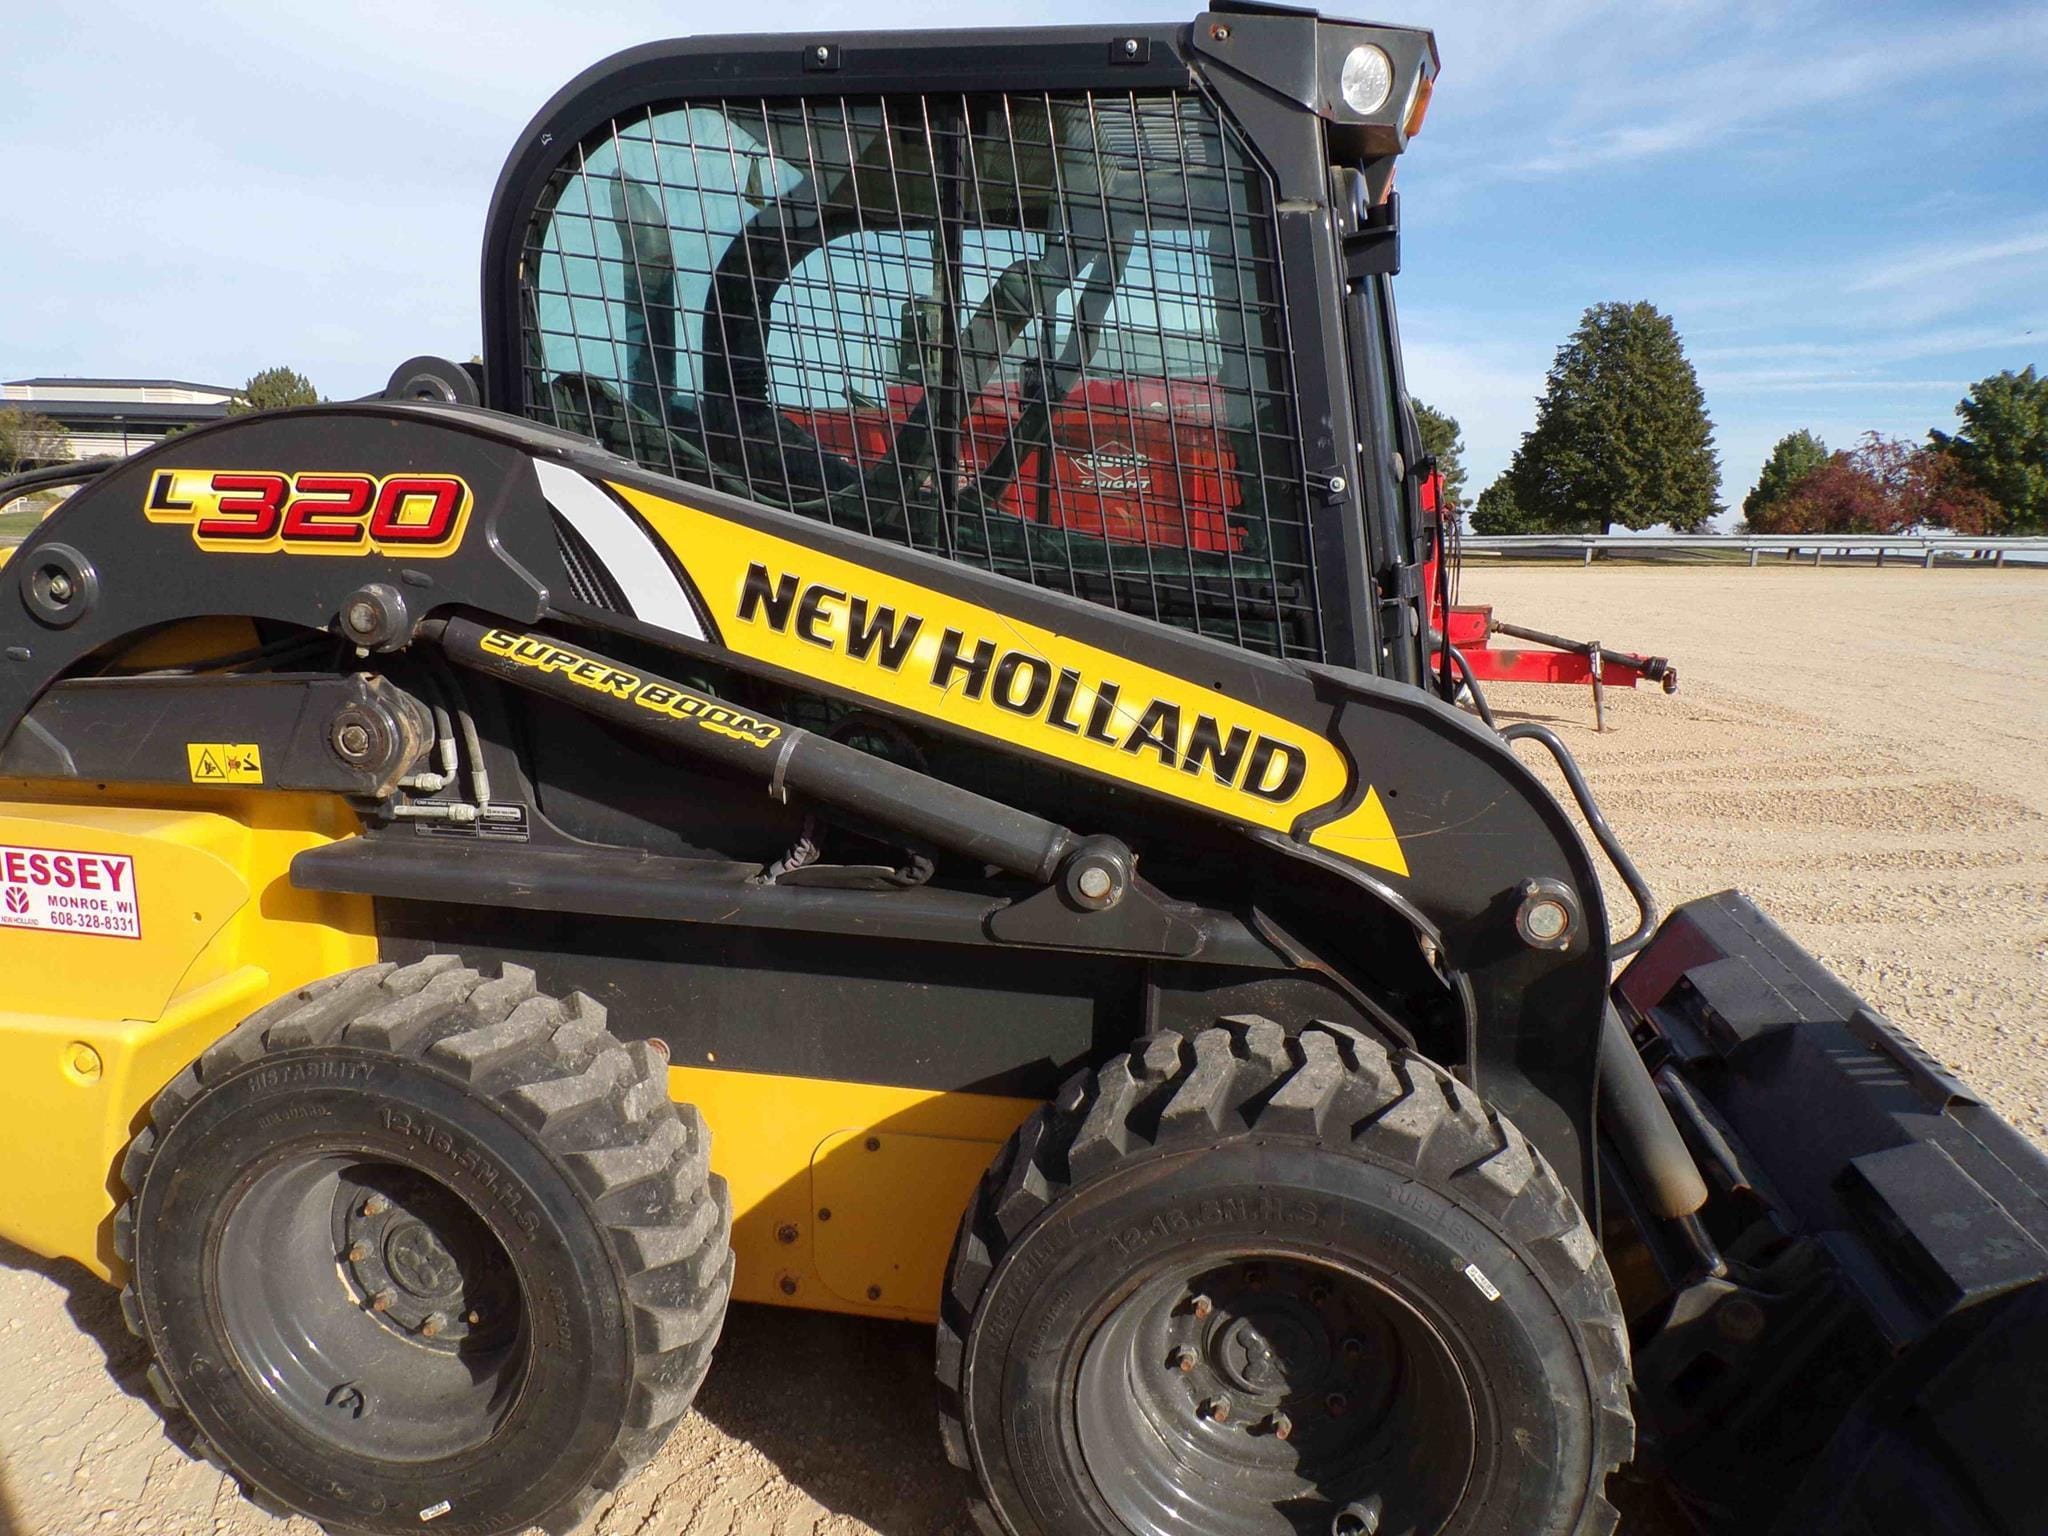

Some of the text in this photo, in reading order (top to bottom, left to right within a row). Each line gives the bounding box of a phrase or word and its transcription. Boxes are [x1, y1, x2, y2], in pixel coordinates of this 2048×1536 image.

[147, 471, 470, 547] L320
[481, 630, 781, 747] SUPER BOOM
[736, 561, 1308, 803] NEW HOLLAND
[0, 851, 126, 892] ESSEY
[48, 895, 133, 914] MONROE, WI
[50, 911, 134, 932] 608-328-8331
